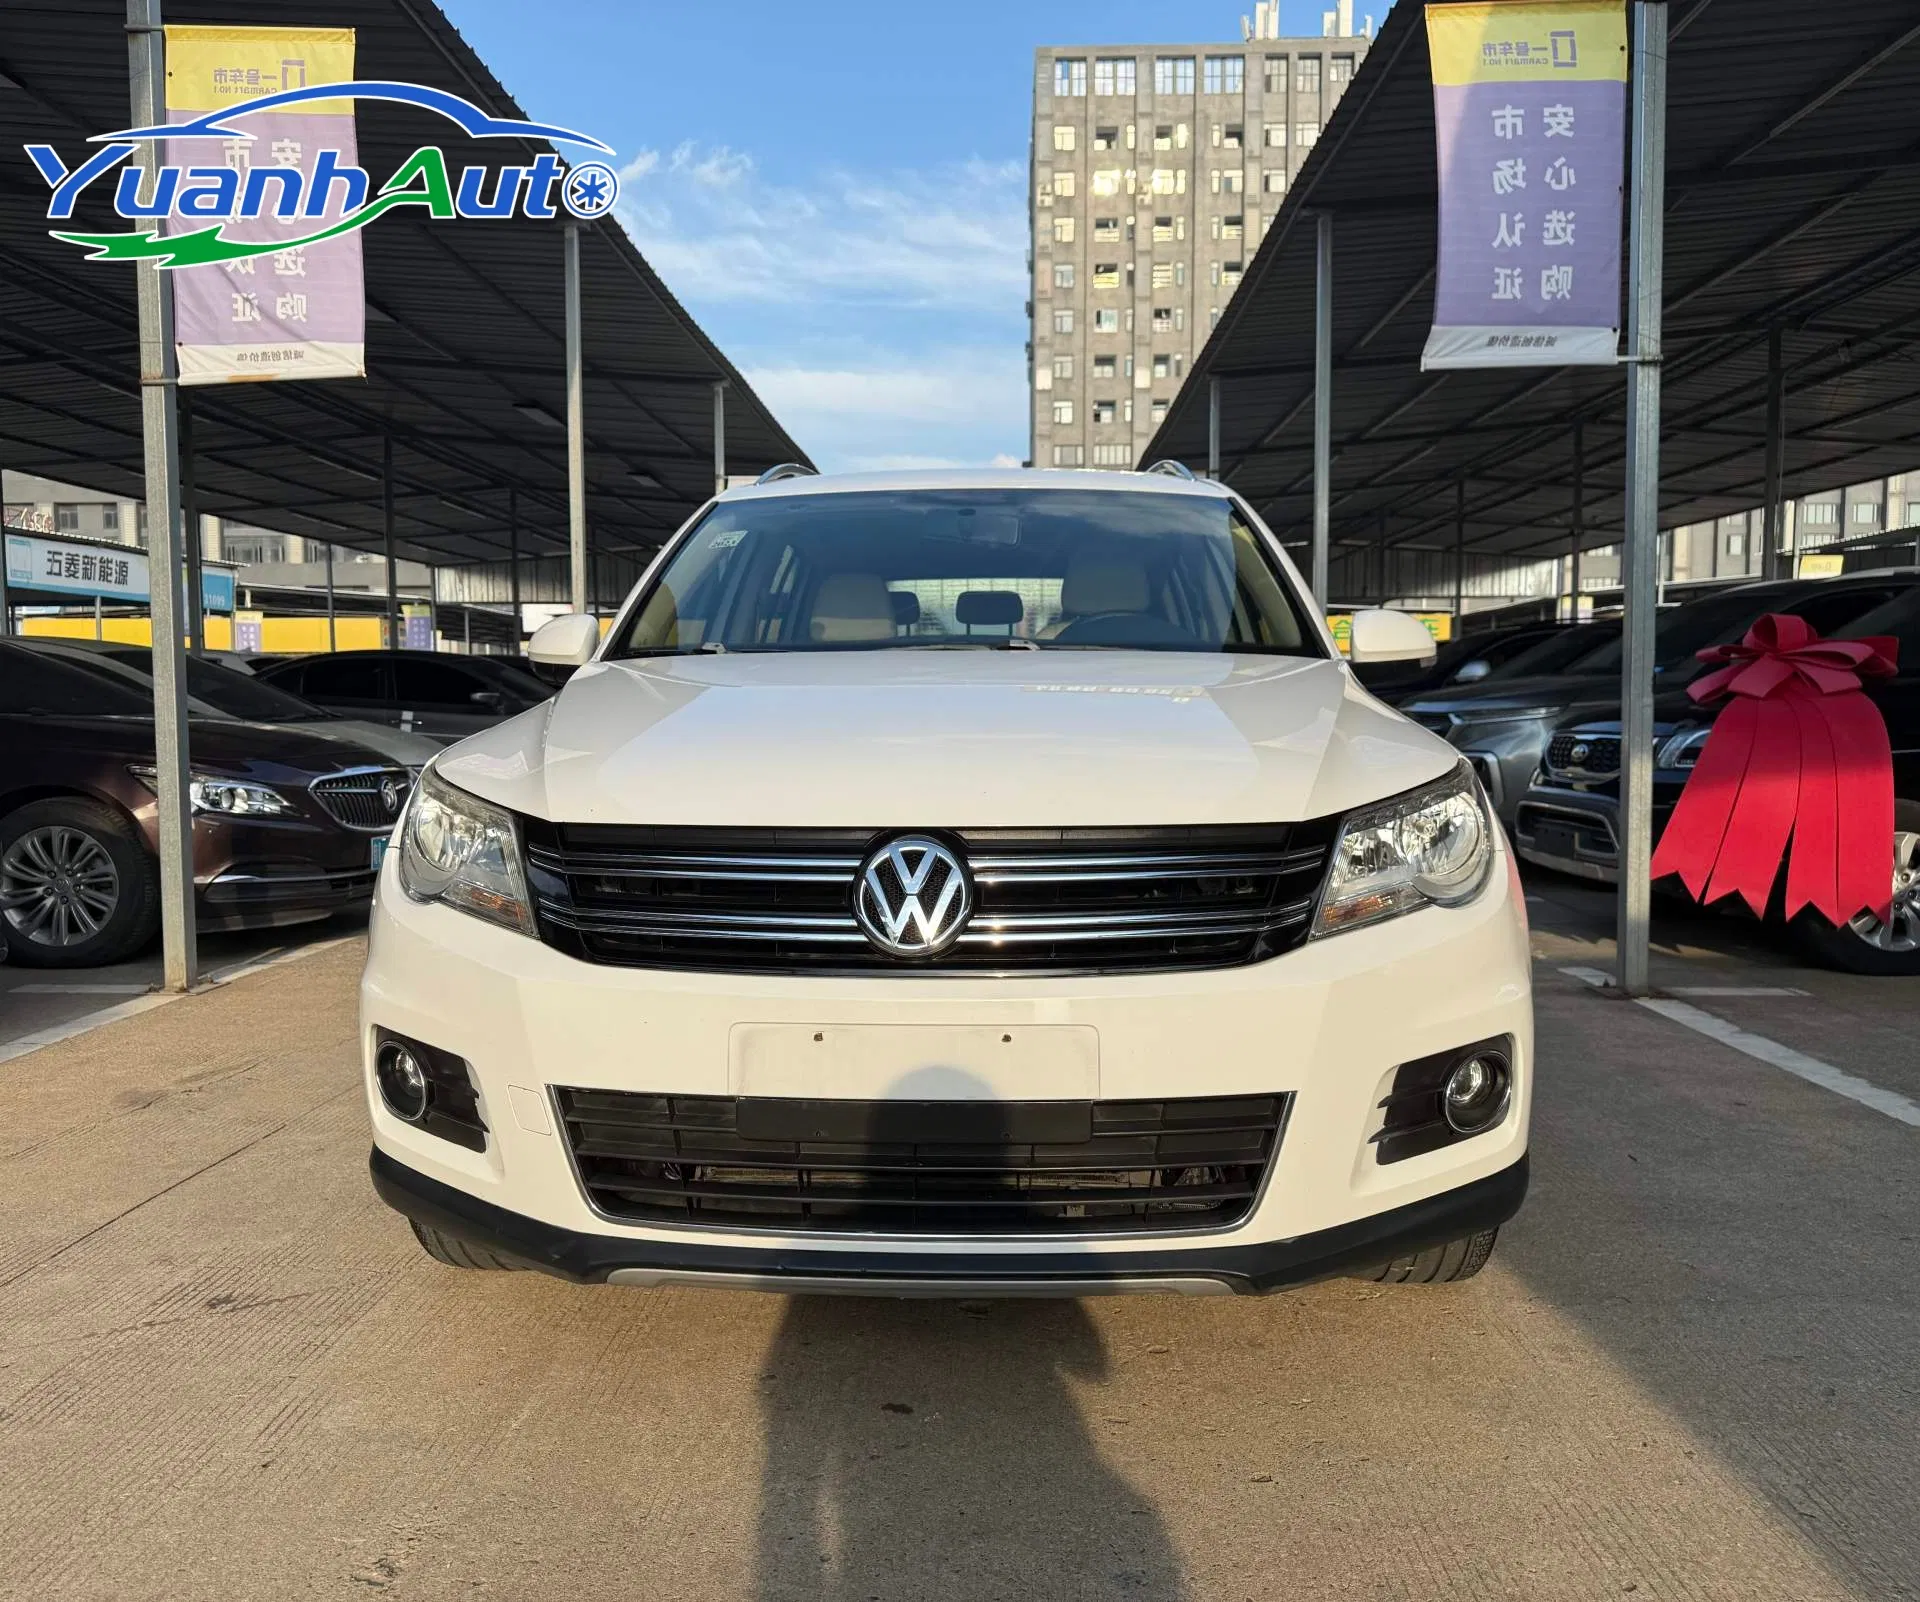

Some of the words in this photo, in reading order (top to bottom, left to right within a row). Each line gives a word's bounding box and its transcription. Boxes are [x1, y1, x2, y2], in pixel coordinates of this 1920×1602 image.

[46, 549, 129, 587] 五菱新能源
